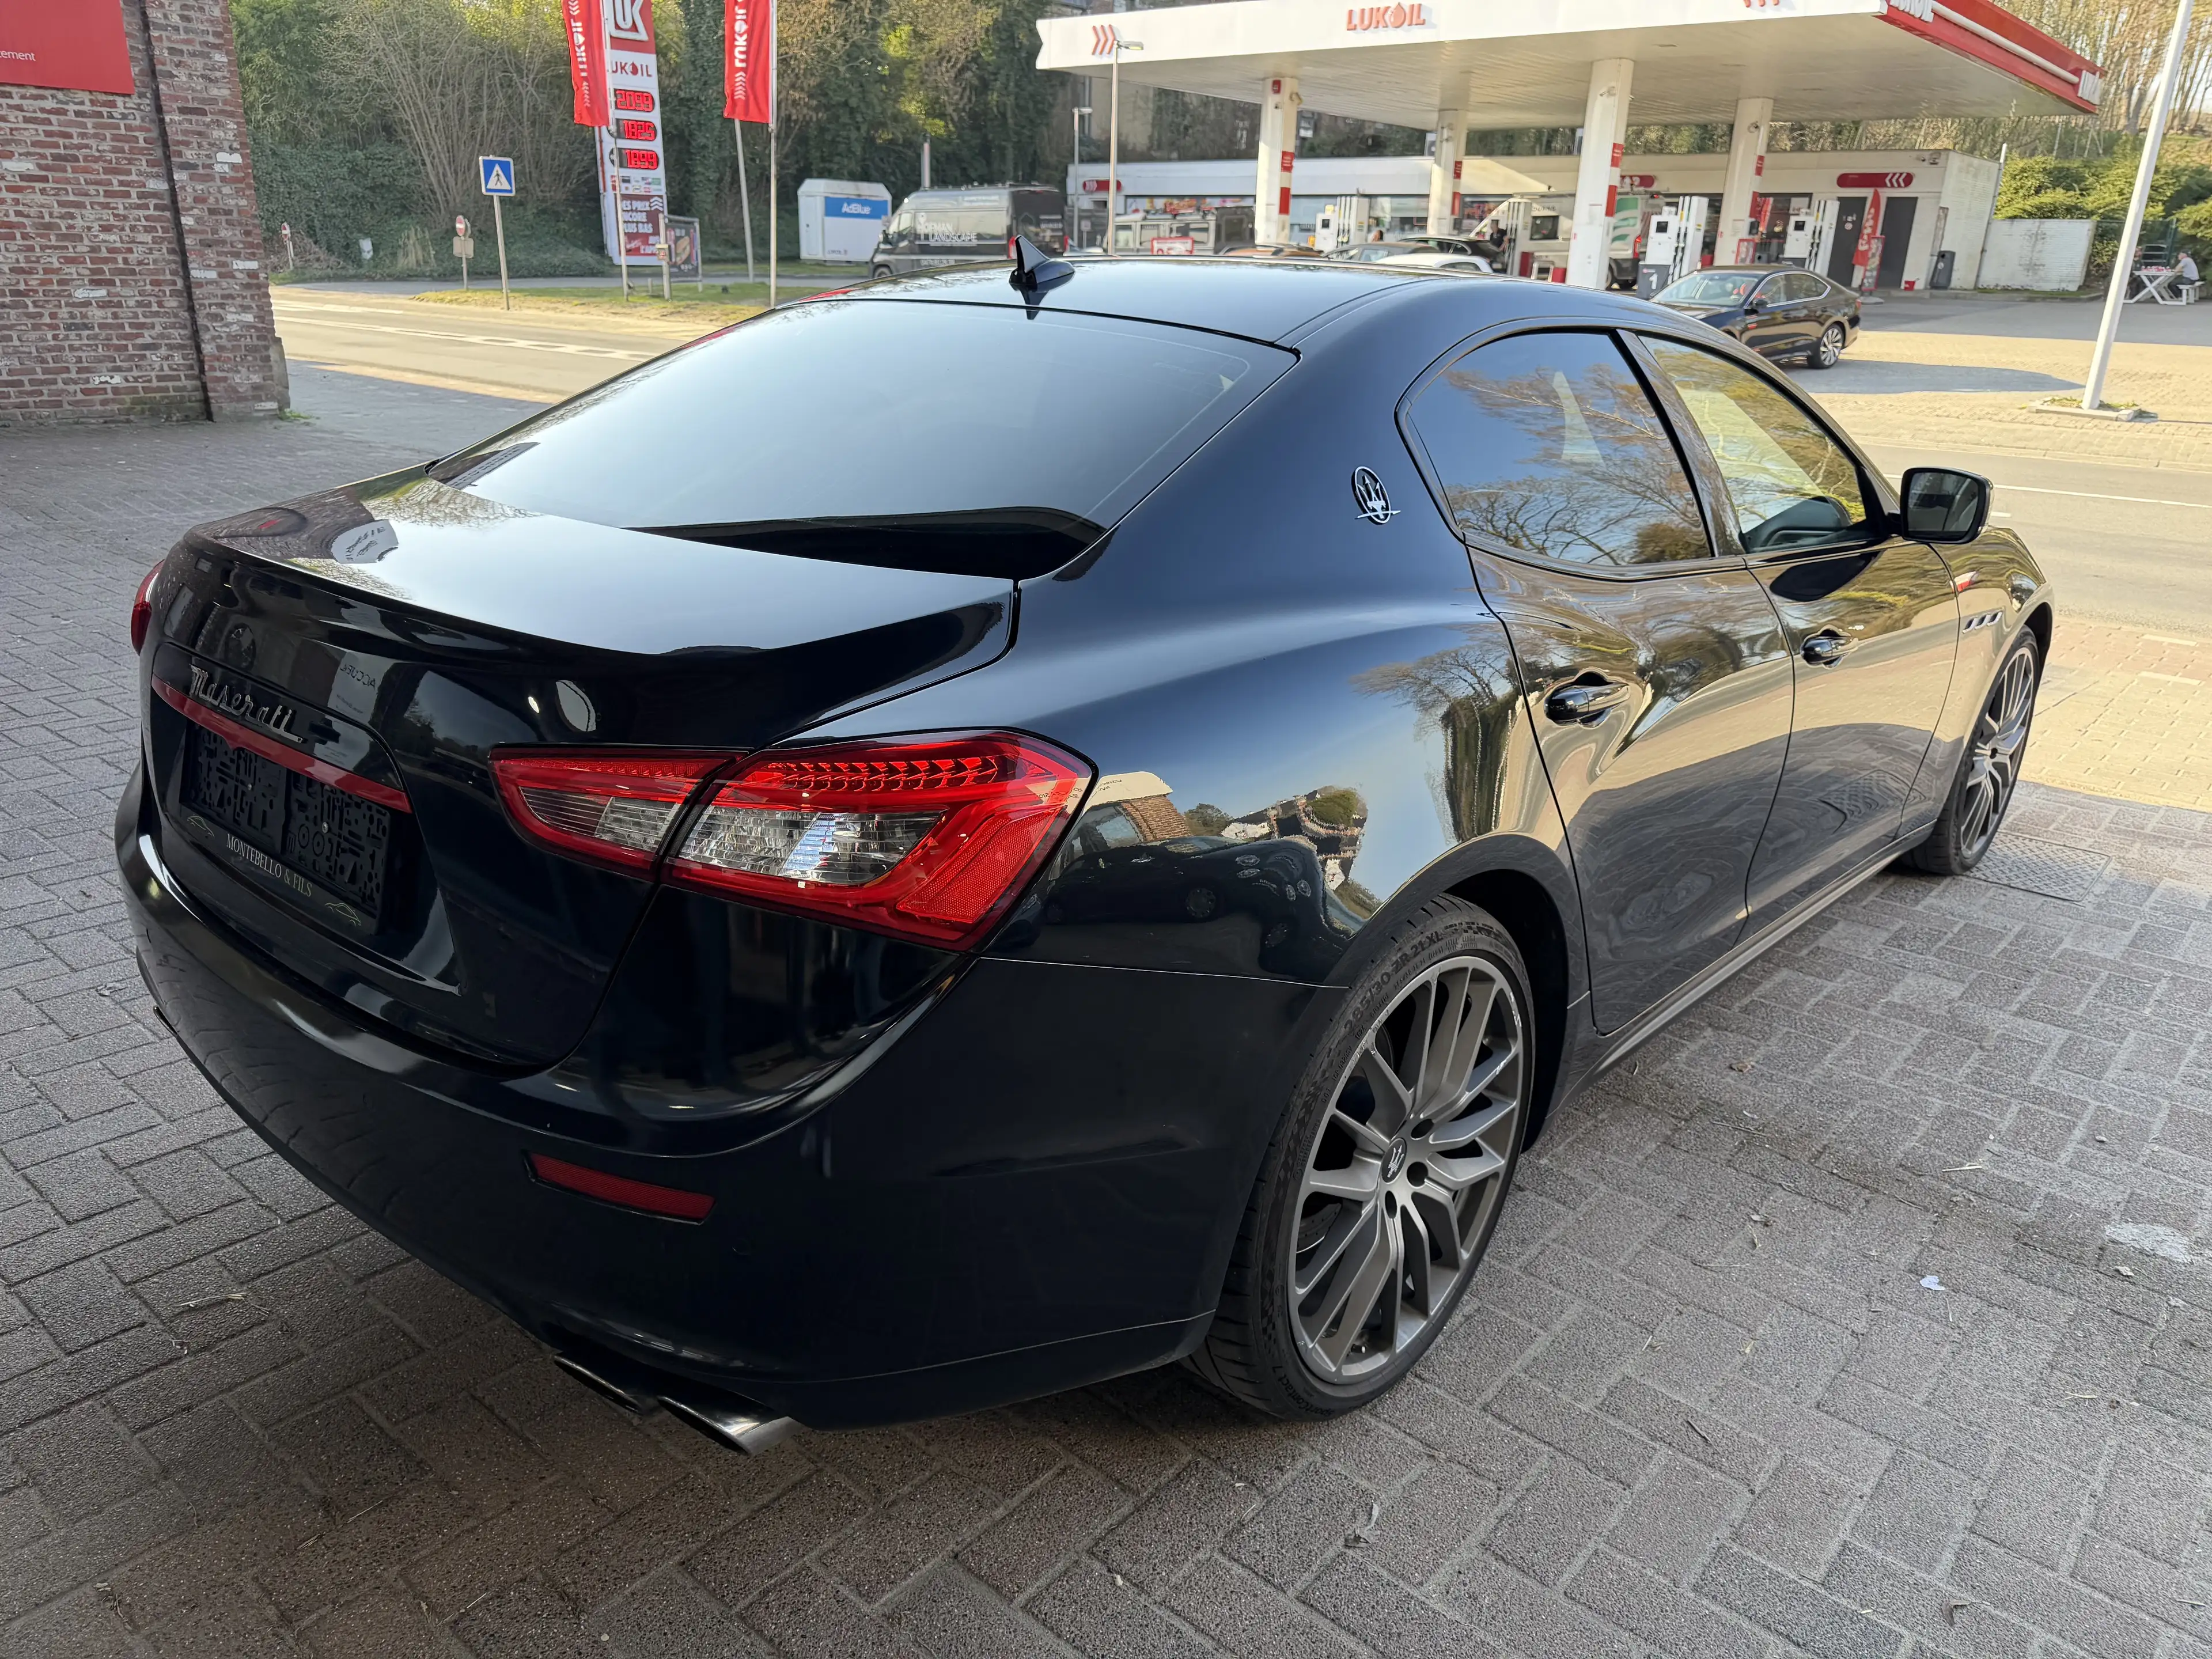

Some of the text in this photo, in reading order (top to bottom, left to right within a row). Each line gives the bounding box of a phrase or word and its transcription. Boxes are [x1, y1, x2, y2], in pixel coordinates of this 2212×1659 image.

[1347, 2, 1426, 31] LUKOIL
[734, 6, 748, 67] LUKOIL
[612, 61, 652, 77] UKOIL
[616, 90, 654, 112] 2099
[623, 120, 655, 141] 1825
[626, 149, 657, 169] 1899
[842, 202, 870, 214] AdBlue
[1649, 274, 1658, 289] 1
[189, 664, 303, 743] Maserati
[226, 834, 312, 897] MONTEBELLO & FILS
